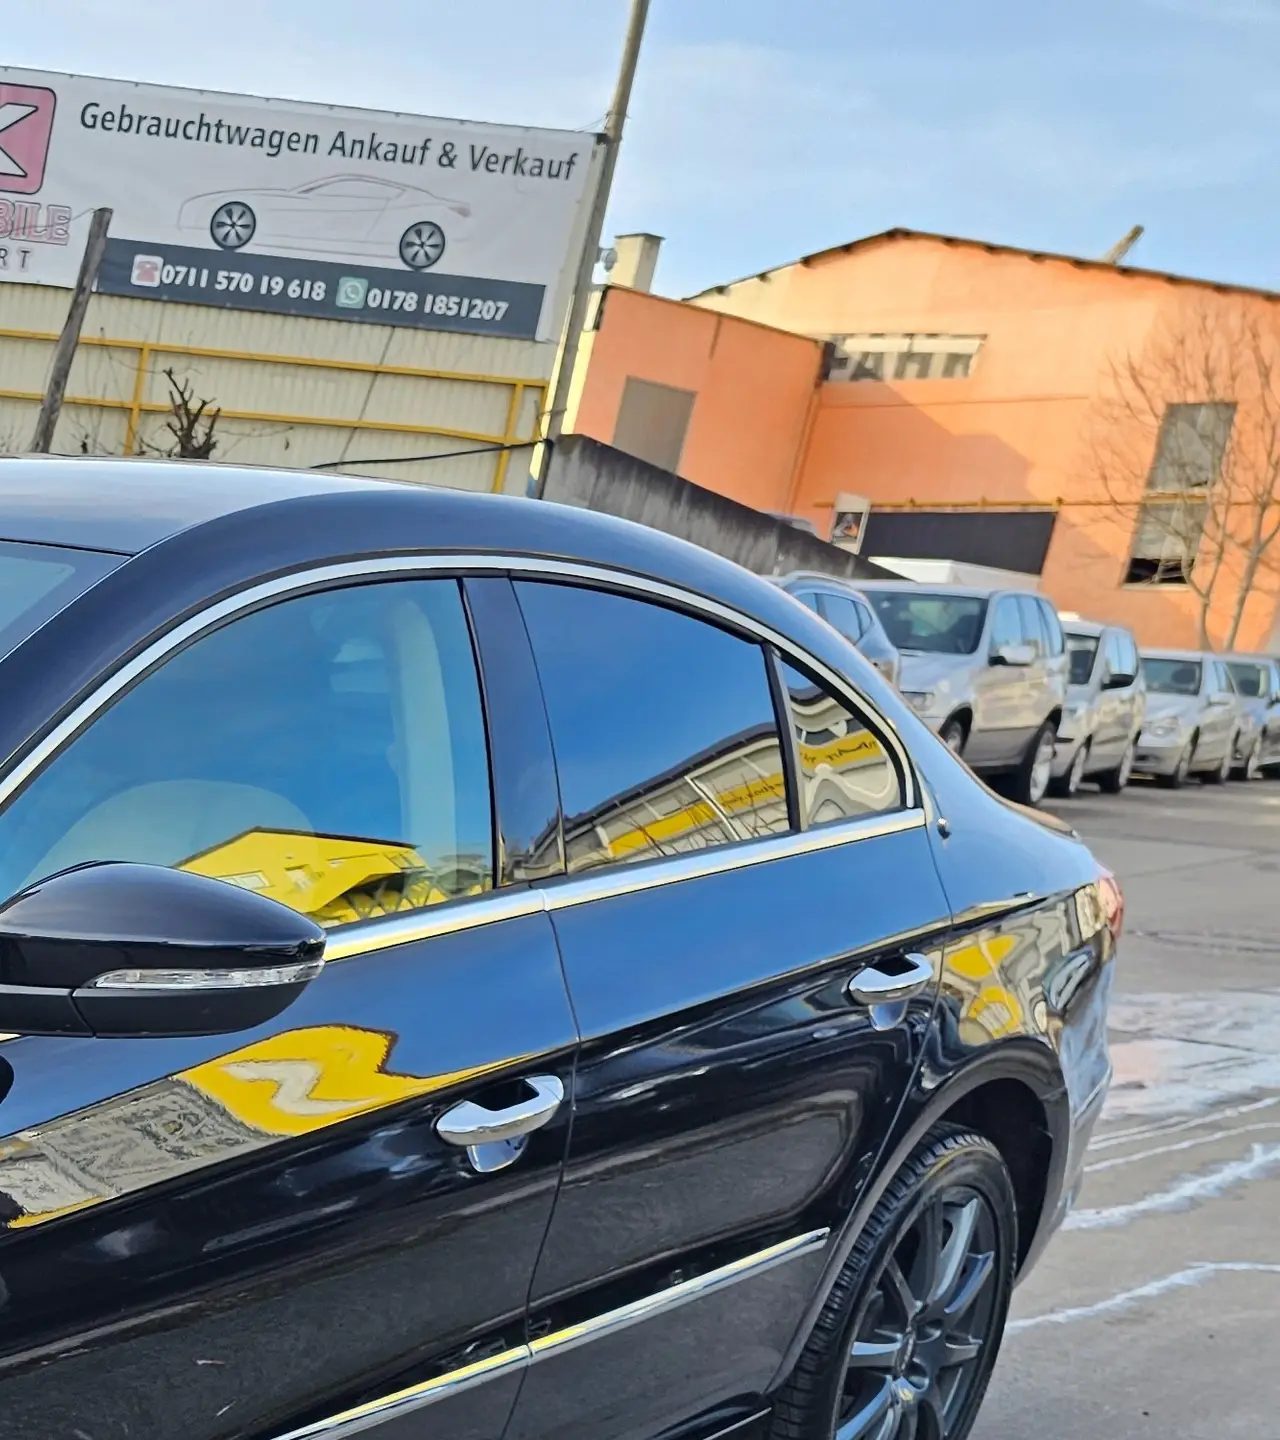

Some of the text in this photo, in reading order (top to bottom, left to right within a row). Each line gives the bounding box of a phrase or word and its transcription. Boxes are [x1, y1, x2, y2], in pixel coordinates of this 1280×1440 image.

[80, 101, 579, 181] Gebrauchtwagen Ankauf & Verkauf
[161, 264, 327, 302] 0711 570 19 618
[367, 287, 510, 321] 0178 1851207
